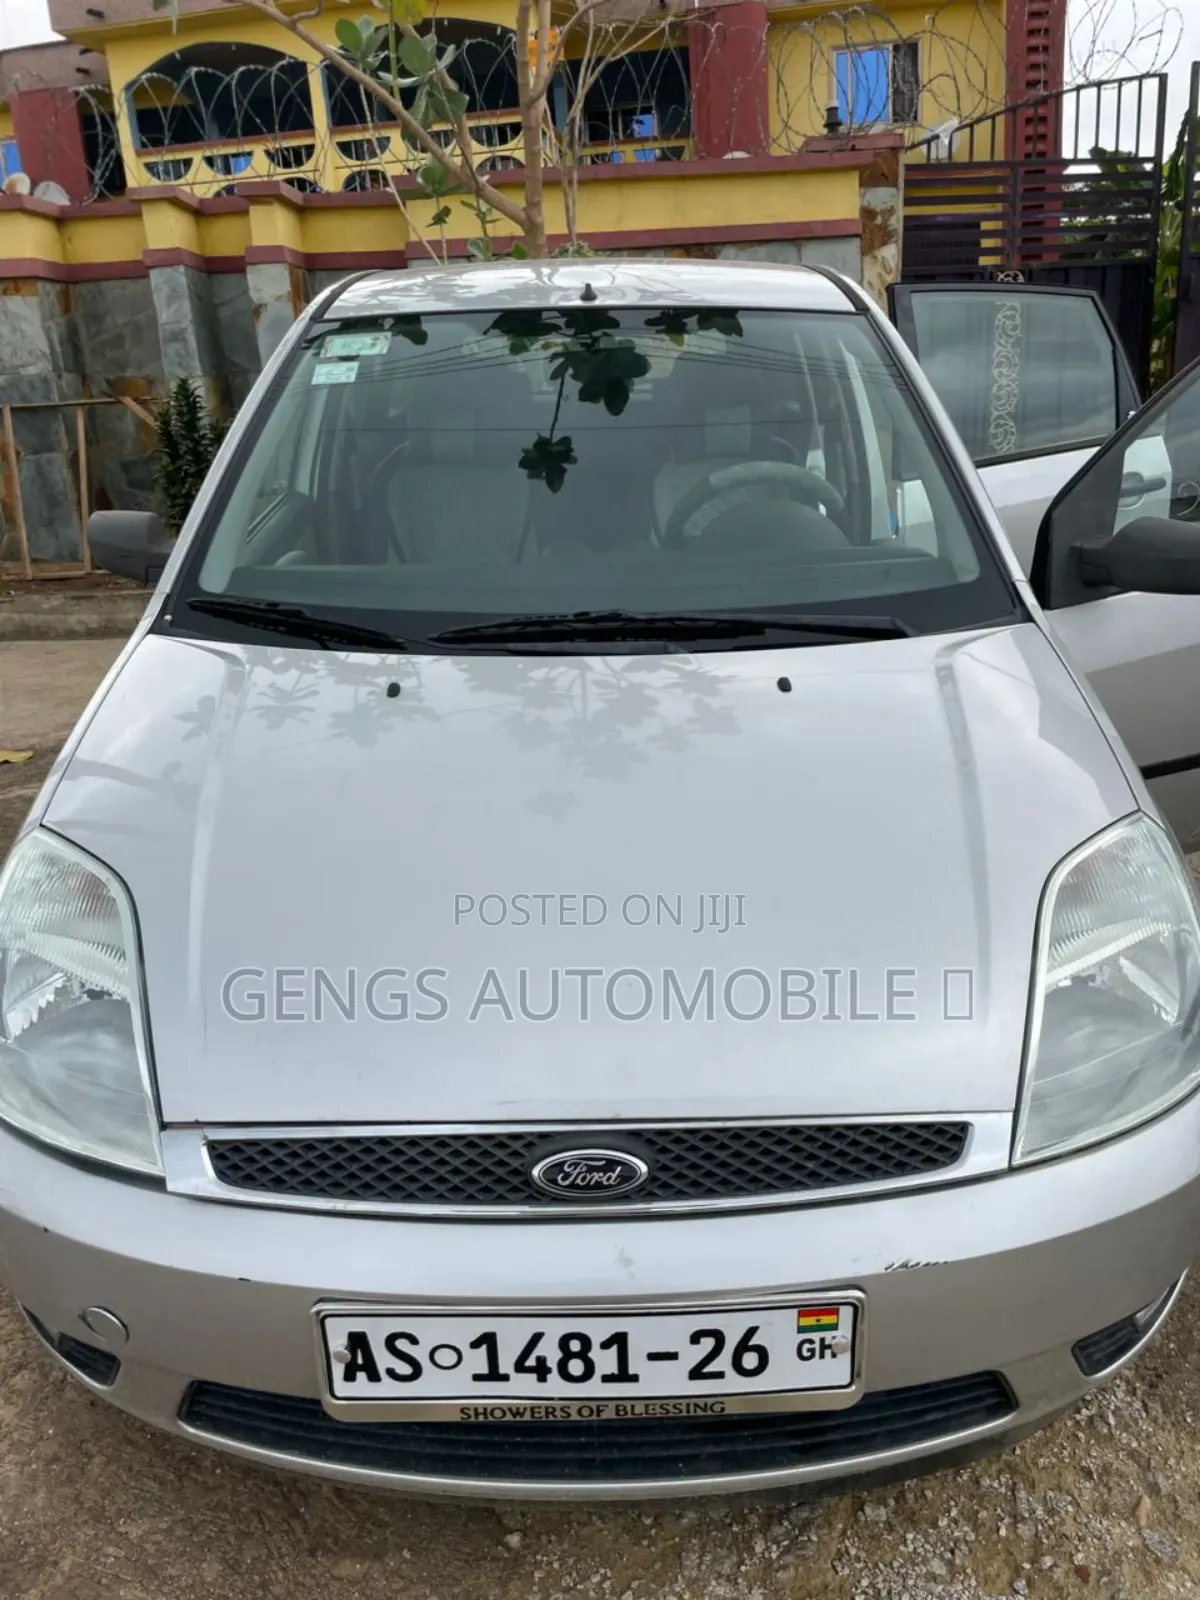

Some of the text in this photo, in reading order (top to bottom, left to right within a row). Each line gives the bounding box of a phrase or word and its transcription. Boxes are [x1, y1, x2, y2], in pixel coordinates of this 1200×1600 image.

[557, 1159, 622, 1186] Ford
[796, 1336, 838, 1362] GH
[459, 1400, 727, 1421] SHOWERS OF BLESSING
